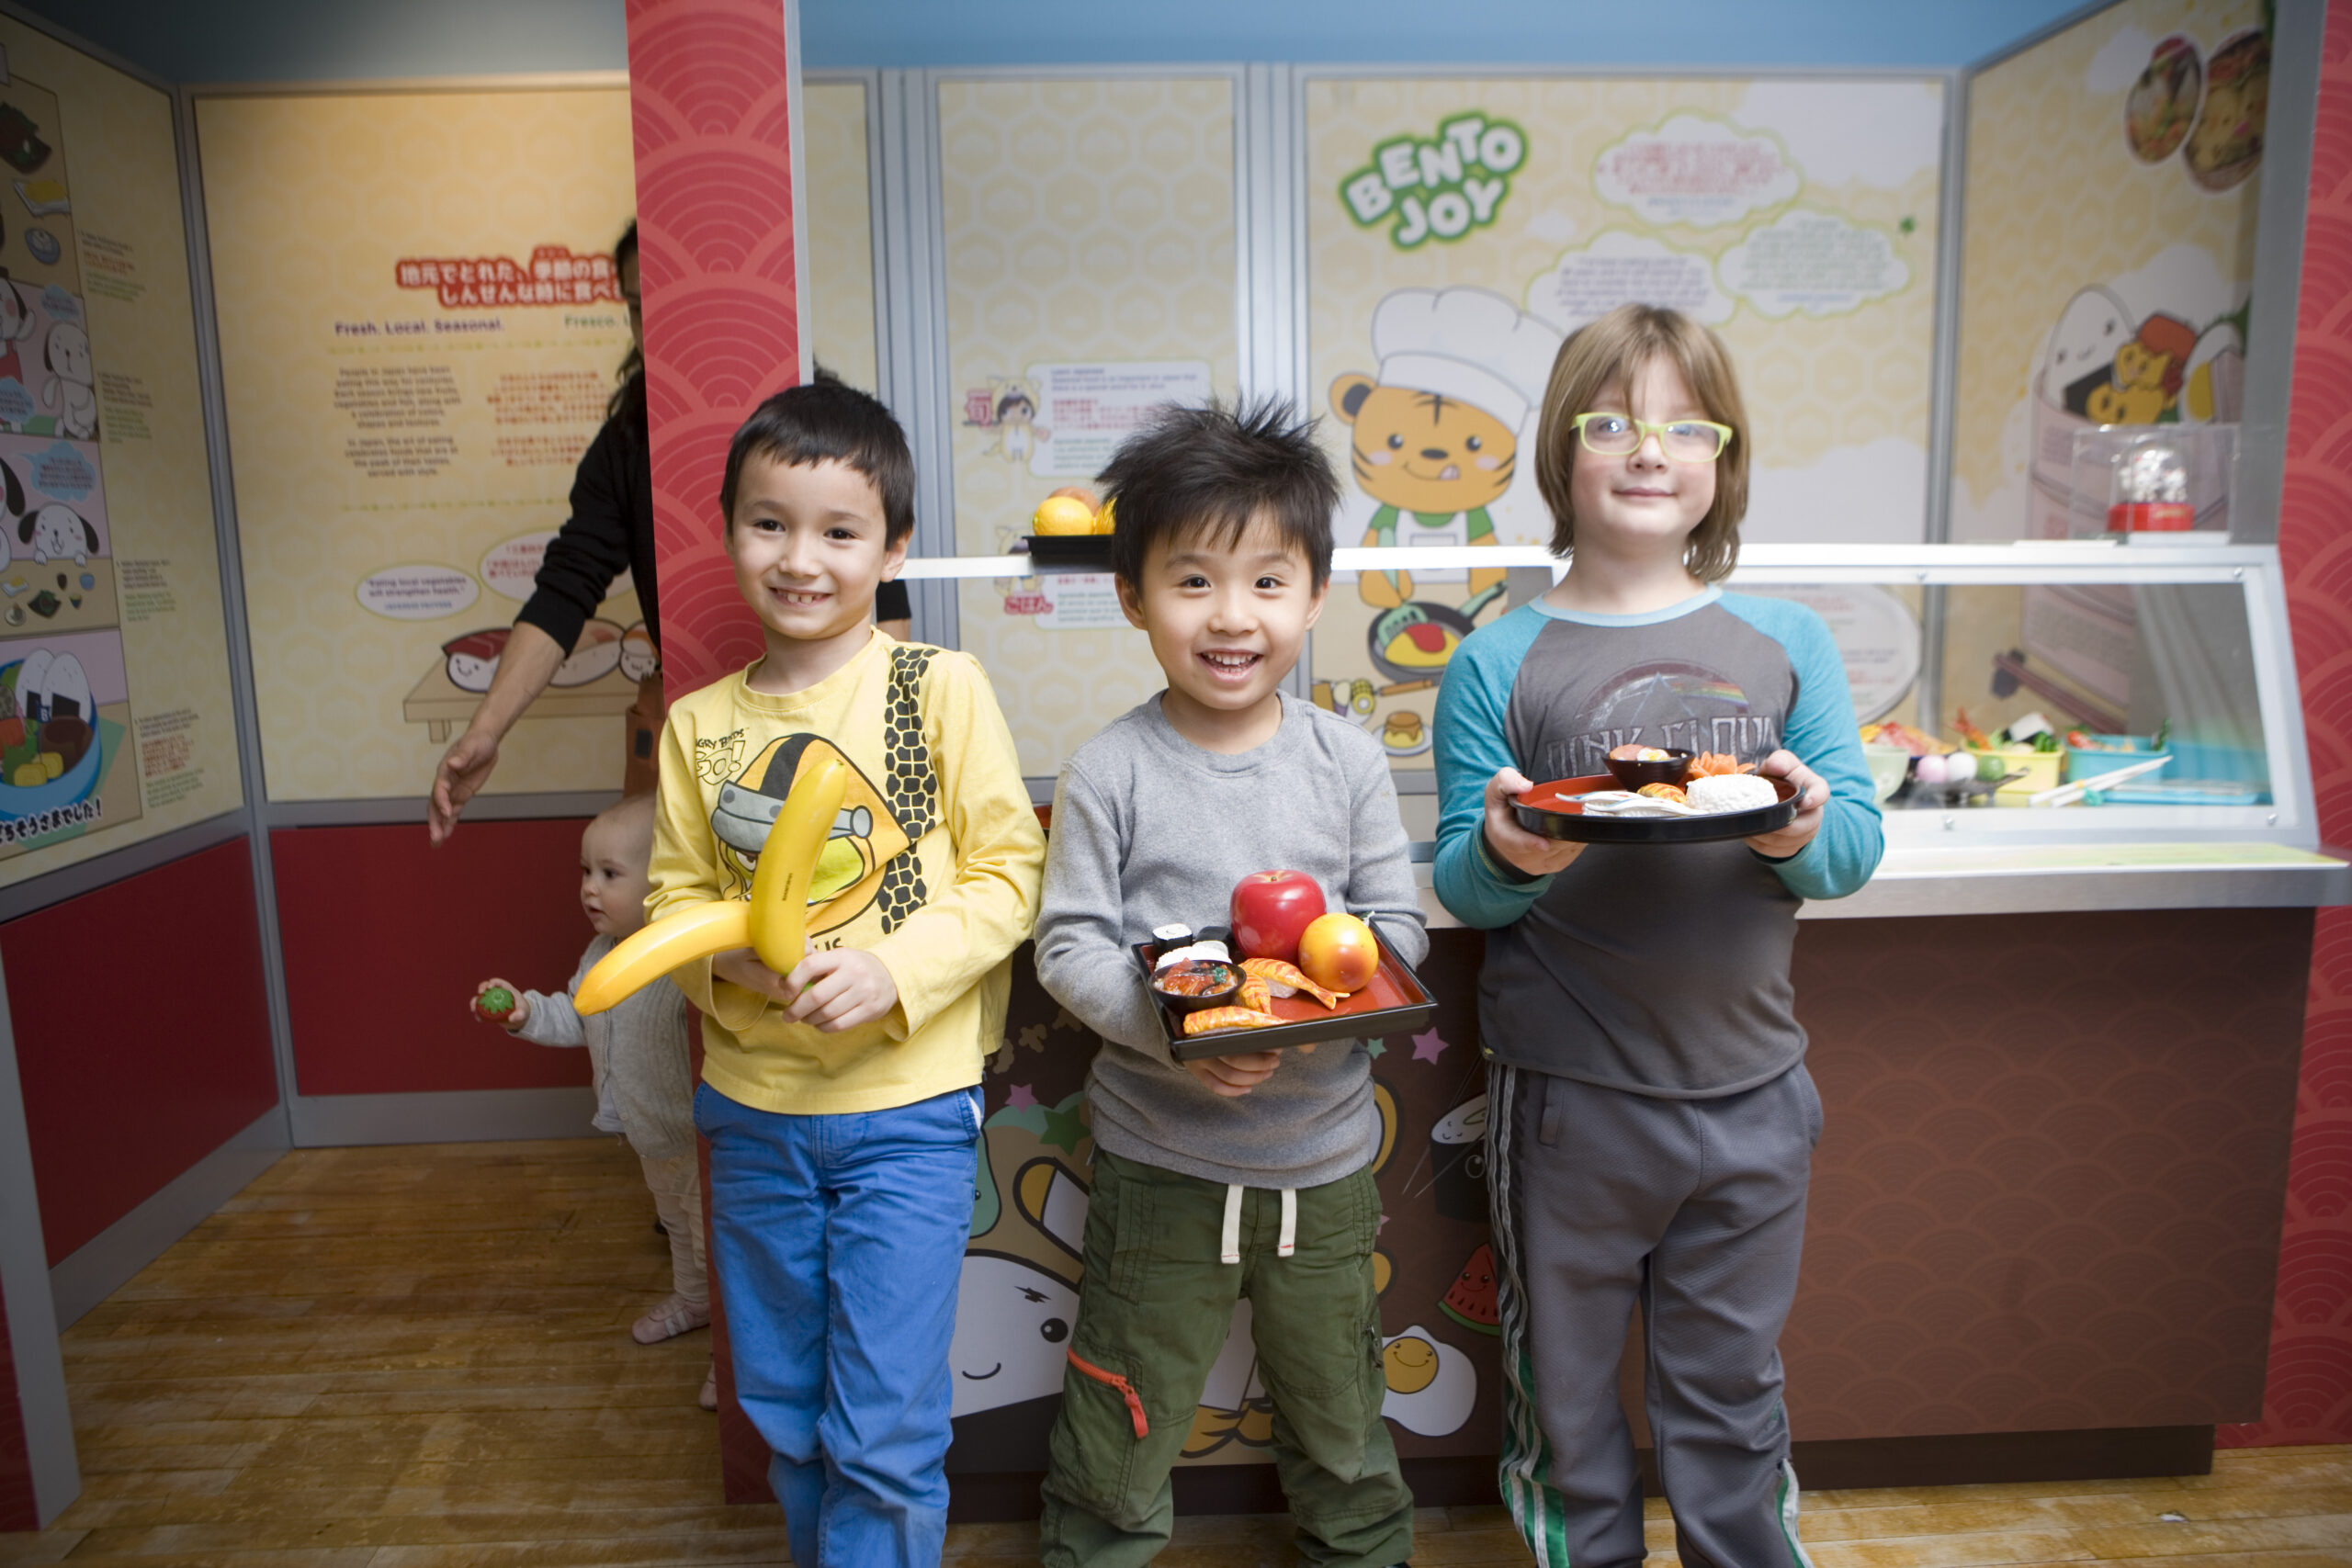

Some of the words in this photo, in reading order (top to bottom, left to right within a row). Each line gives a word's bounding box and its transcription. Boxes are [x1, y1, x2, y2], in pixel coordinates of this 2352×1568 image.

[1346, 117, 1523, 223] BENTO
[1397, 177, 1505, 246] JOY
[401, 259, 617, 285] 地元でとれた、季節の食
[334, 321, 380, 337] Fresh.
[385, 320, 428, 335] Local.
[434, 318, 505, 334] Seasonal.
[0, 798, 101, 843] ちそうさまでした!
